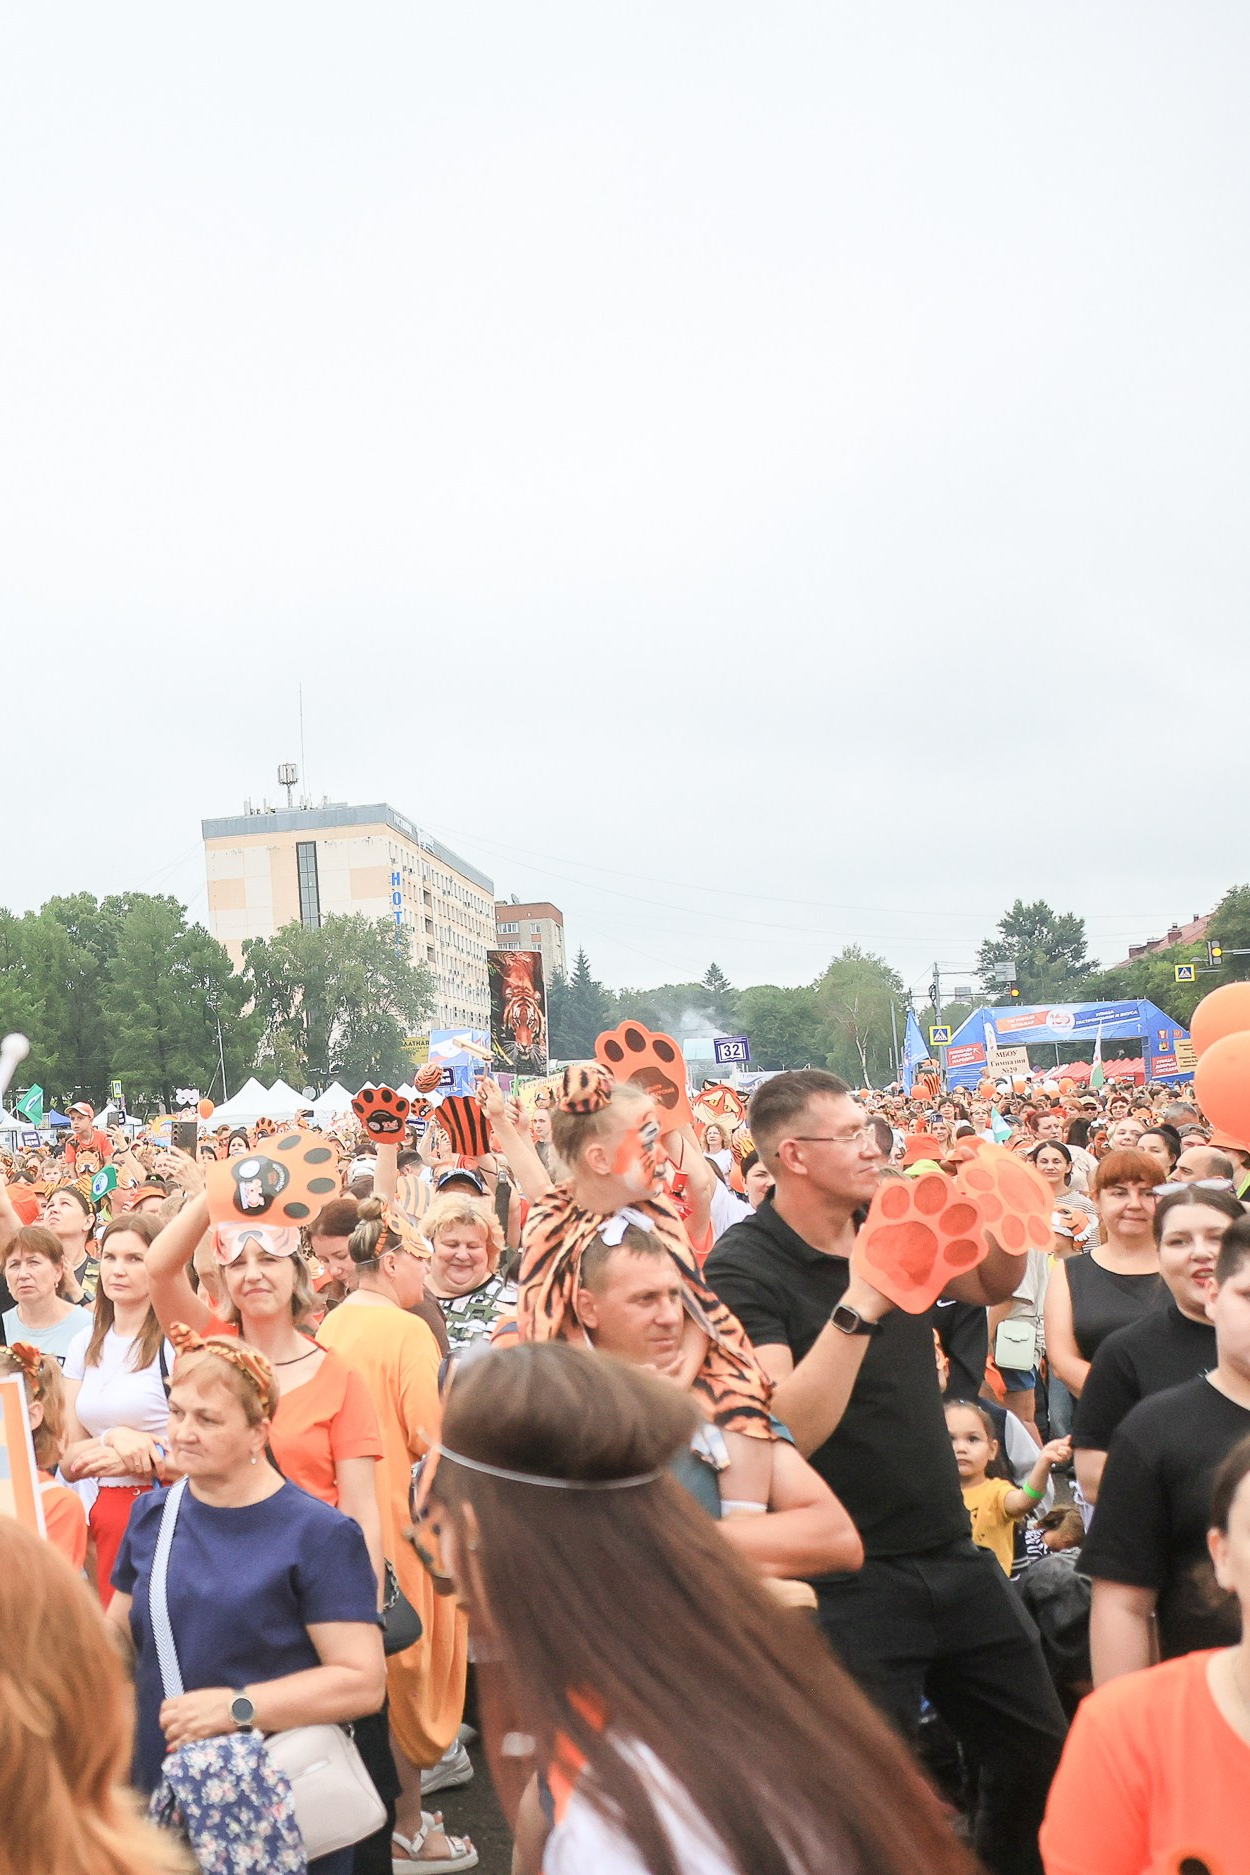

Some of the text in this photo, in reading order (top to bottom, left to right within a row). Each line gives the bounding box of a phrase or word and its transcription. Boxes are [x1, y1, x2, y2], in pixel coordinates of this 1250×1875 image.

[723, 1044, 741, 1057] 32
[996, 1050, 1018, 1058] МБОУ
[990, 1059, 1026, 1067] Гимназия
